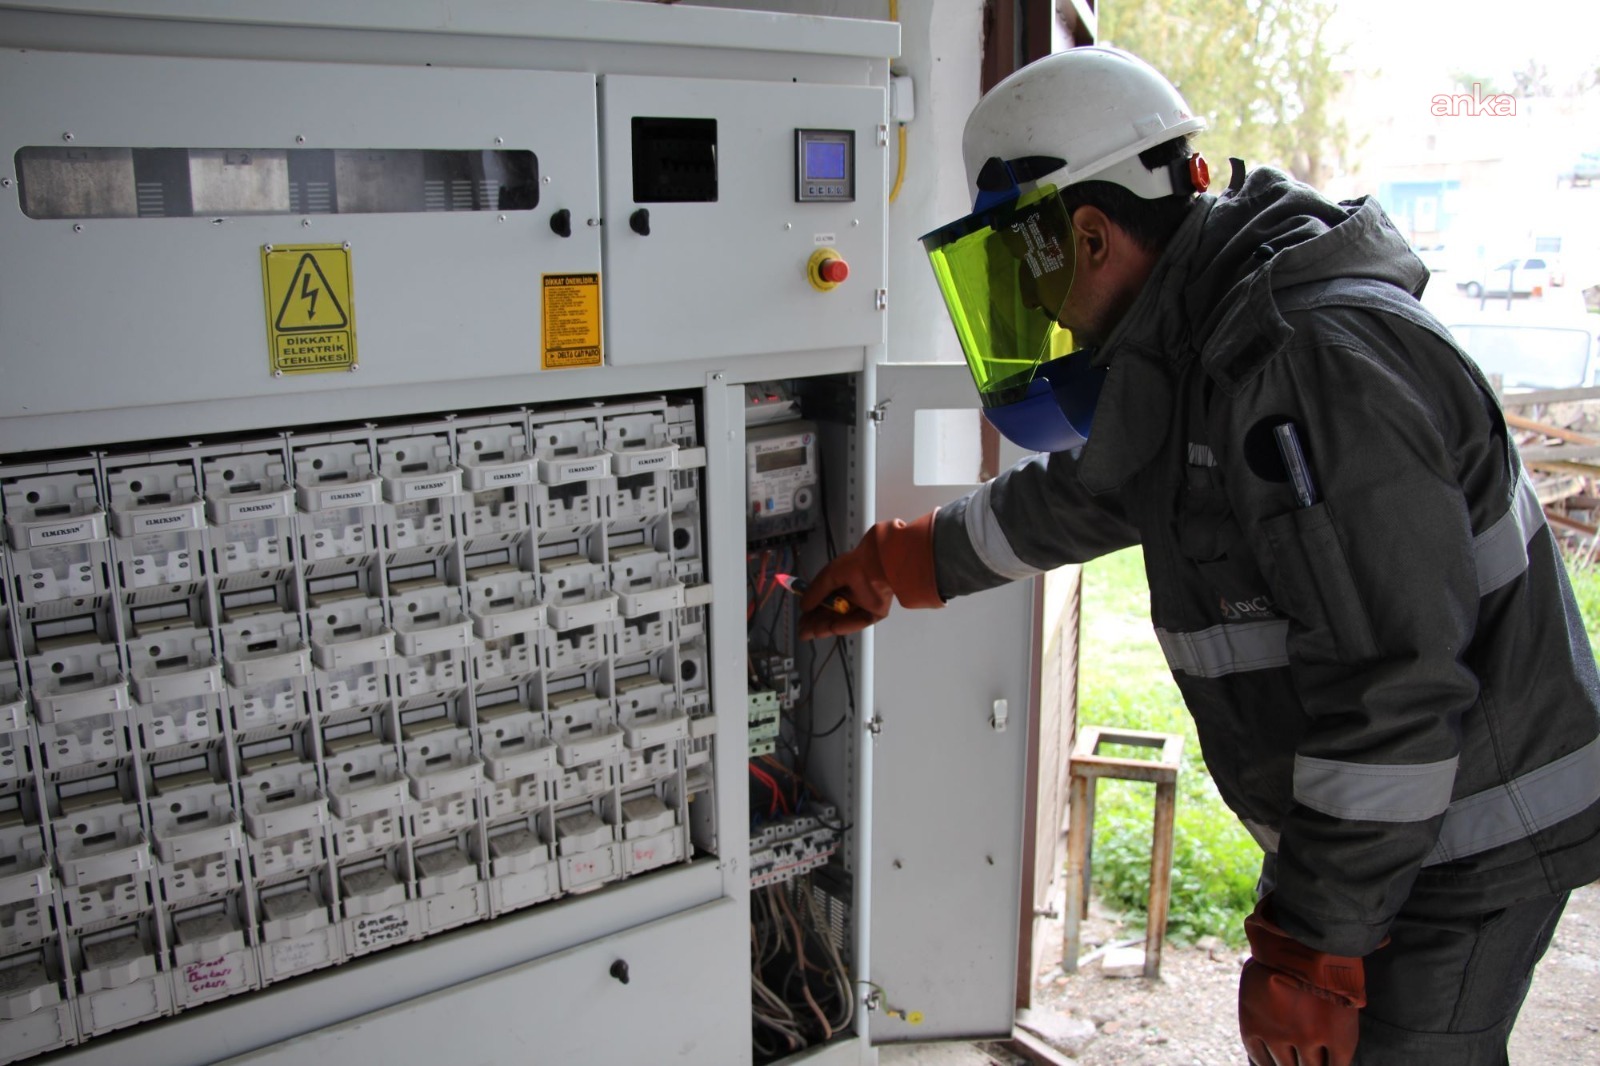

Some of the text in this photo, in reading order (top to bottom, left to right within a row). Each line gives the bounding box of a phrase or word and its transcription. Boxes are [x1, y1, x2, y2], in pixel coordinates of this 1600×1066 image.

[287, 336, 332, 346] DİKKAT
[284, 344, 345, 356] ELEKTRİK
[282, 353, 347, 365] TEHLİKESİ
